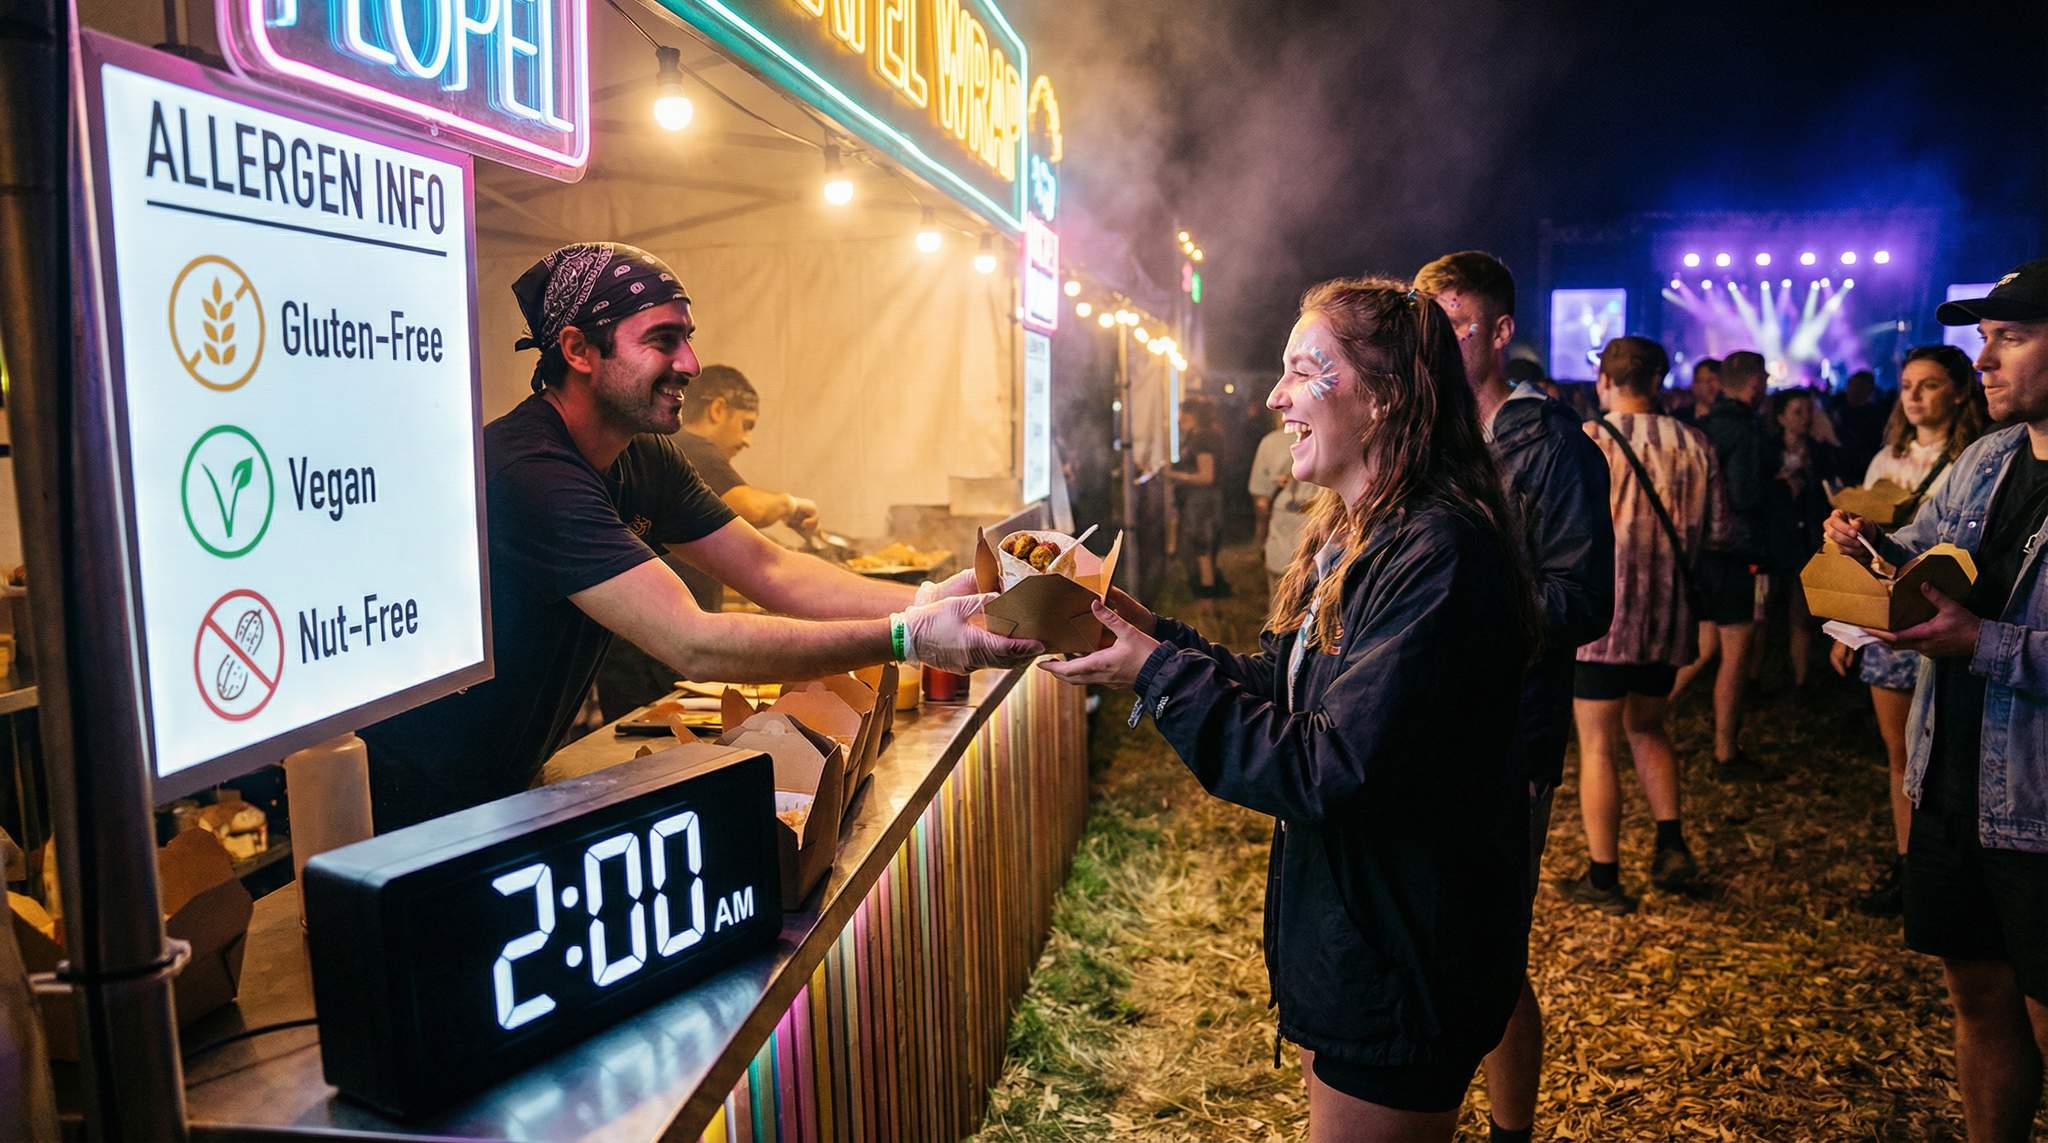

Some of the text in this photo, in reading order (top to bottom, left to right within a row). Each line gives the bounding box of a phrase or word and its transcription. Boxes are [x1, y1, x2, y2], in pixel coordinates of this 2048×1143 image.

[934, 0, 1022, 182] WRAP
[146, 100, 445, 235] ALLERGEN INFO
[281, 300, 443, 363] Gluten-Free
[288, 456, 376, 522] Vegan
[298, 593, 418, 665] Nut-Free
[491, 810, 755, 1031] 2:00 AM
